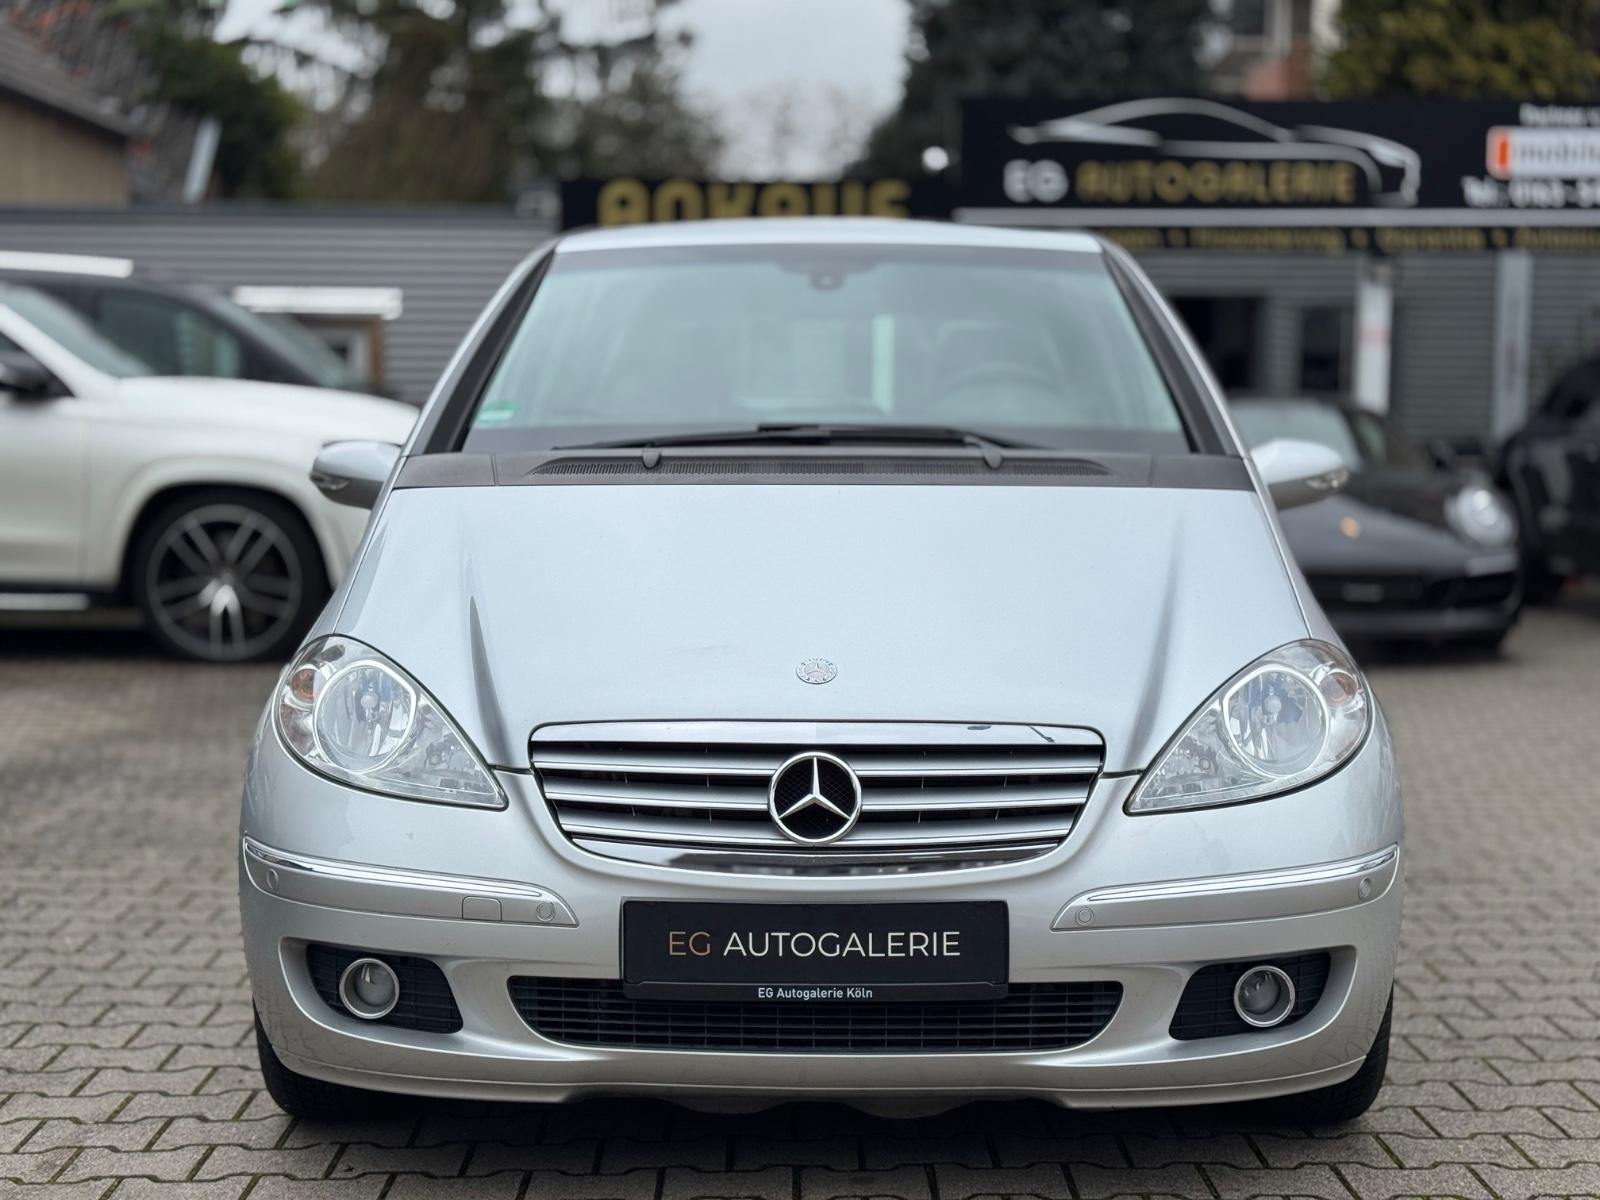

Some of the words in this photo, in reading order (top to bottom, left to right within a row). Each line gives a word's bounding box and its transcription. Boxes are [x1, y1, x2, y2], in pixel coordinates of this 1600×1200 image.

[1004, 160, 1068, 203] EG
[1077, 161, 1354, 203] AUTOGALERIE
[668, 931, 712, 957] EG
[723, 931, 961, 957] AUTOGALERIE
[757, 987, 774, 999] EG
[776, 987, 844, 1001] Autogalerie
[846, 987, 873, 999] Köln
